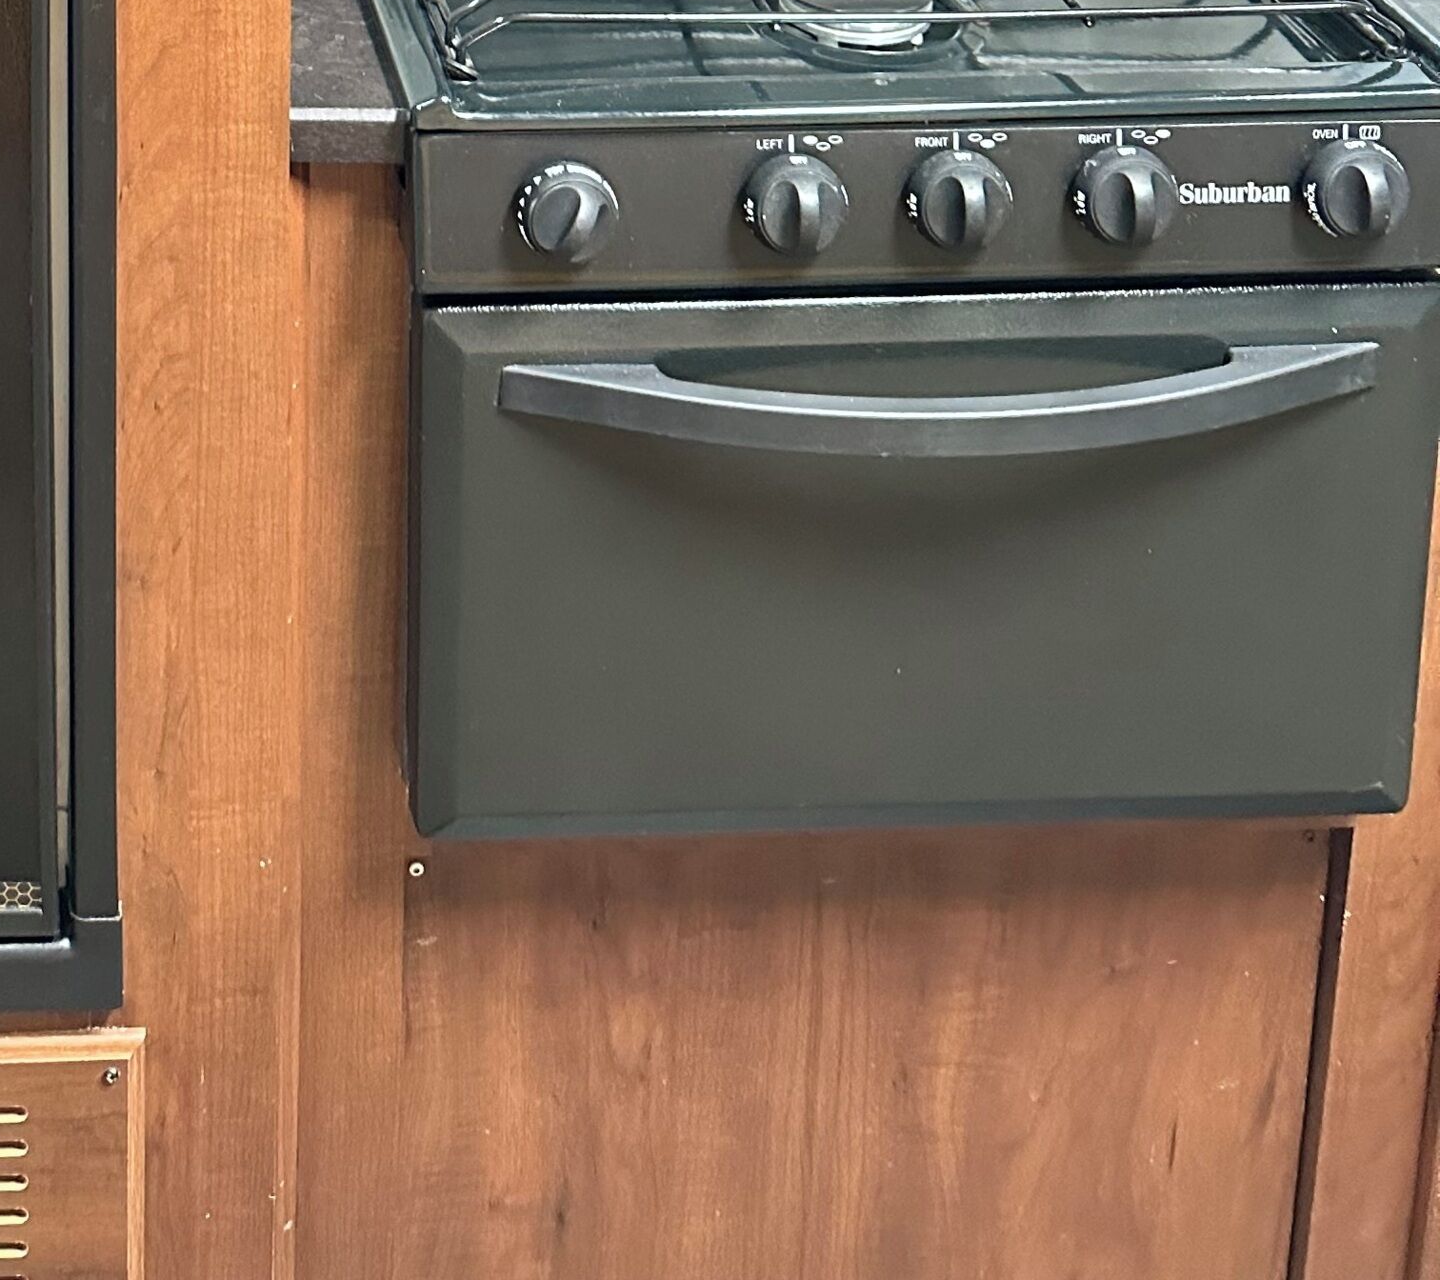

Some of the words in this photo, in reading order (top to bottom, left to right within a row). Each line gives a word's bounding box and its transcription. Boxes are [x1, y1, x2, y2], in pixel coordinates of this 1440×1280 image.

[1078, 133, 1112, 144] RIGHT
[1312, 128, 1339, 140] OVEN
[756, 138, 784, 150] LEFT
[914, 136, 949, 148] FRONT
[1179, 181, 1291, 204] Suburban
